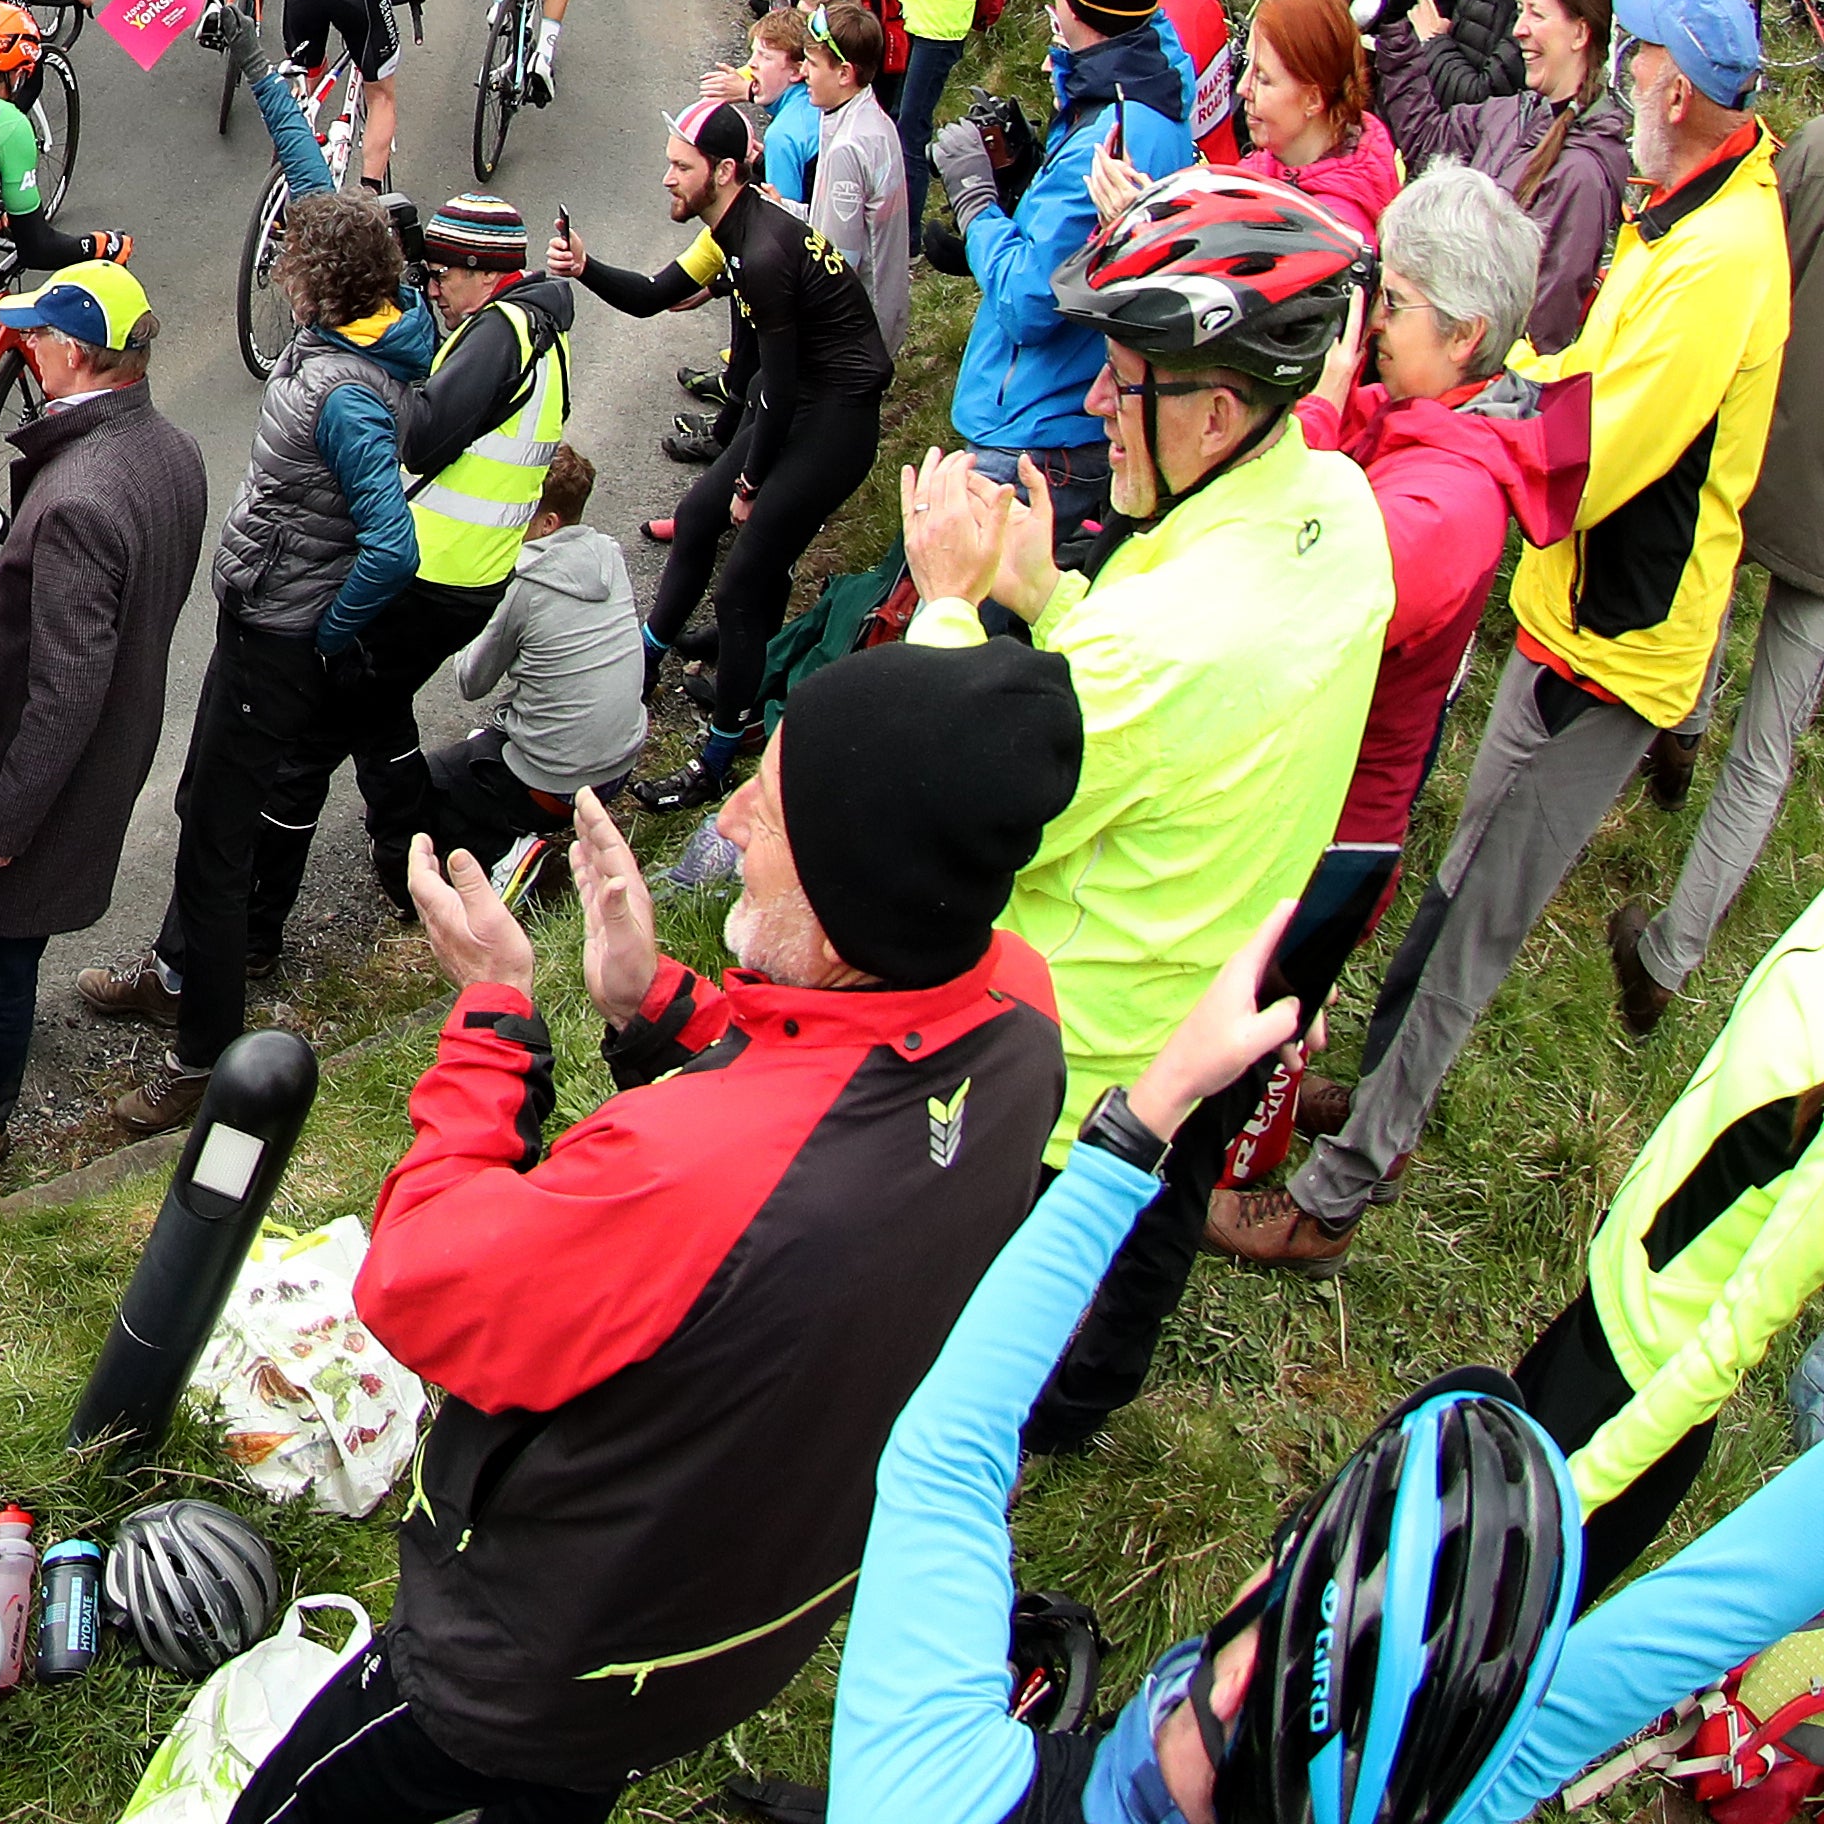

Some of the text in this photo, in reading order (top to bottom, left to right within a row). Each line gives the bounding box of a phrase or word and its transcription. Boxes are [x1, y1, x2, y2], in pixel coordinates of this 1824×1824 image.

[122, 0, 146, 22] Have
[79, 1594, 94, 1652] HYDRATE
[1308, 1626, 1335, 1736] GIRO
